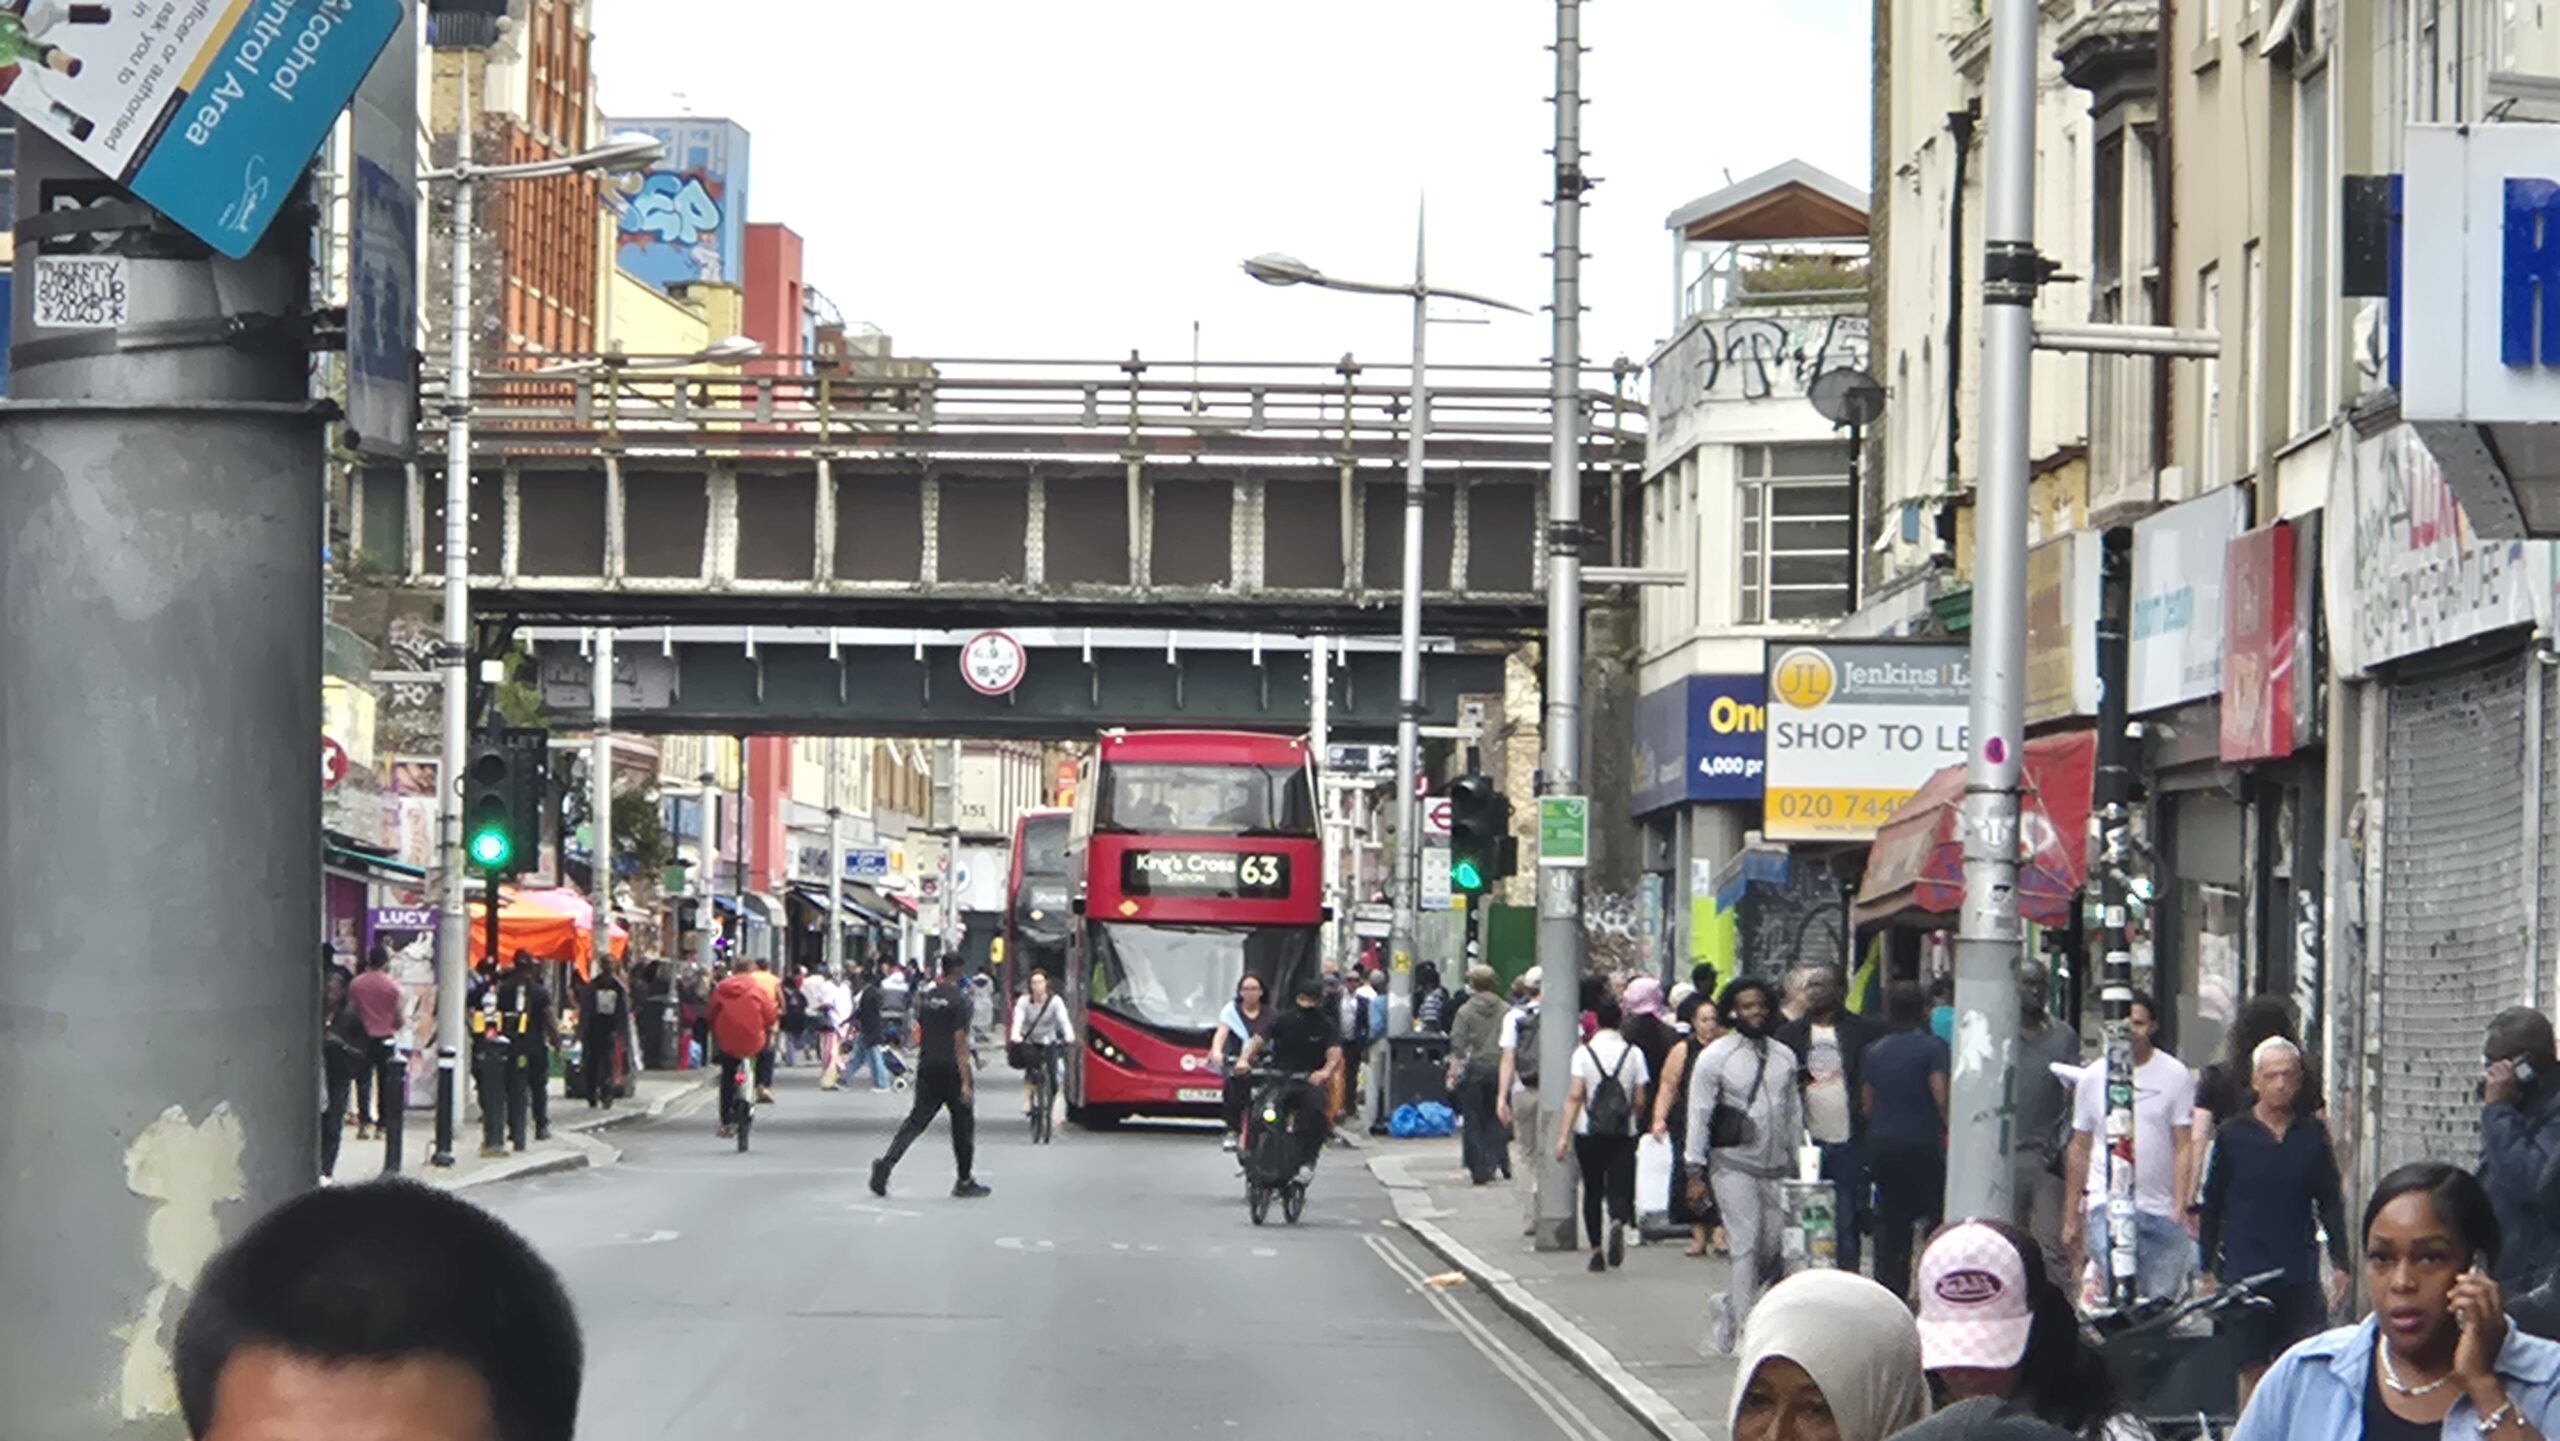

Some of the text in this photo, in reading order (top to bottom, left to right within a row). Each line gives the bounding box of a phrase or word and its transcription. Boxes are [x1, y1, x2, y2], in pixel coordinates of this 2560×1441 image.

[116, 1, 176, 85] ask you to
[161, 43, 177, 64] or
[103, 64, 164, 152] authorised
[184, 71, 245, 146] Area
[1842, 661, 1938, 694] Jenkins
[1777, 722, 1867, 750] SHOP
[1878, 724, 1924, 751] TO
[1700, 756, 1744, 777] 4,000
[961, 804, 986, 817] 151
[1779, 793, 1833, 818] 020
[1136, 854, 1237, 876] King's Cross
[1240, 856, 1280, 885] 63
[379, 910, 431, 924] LUCY
